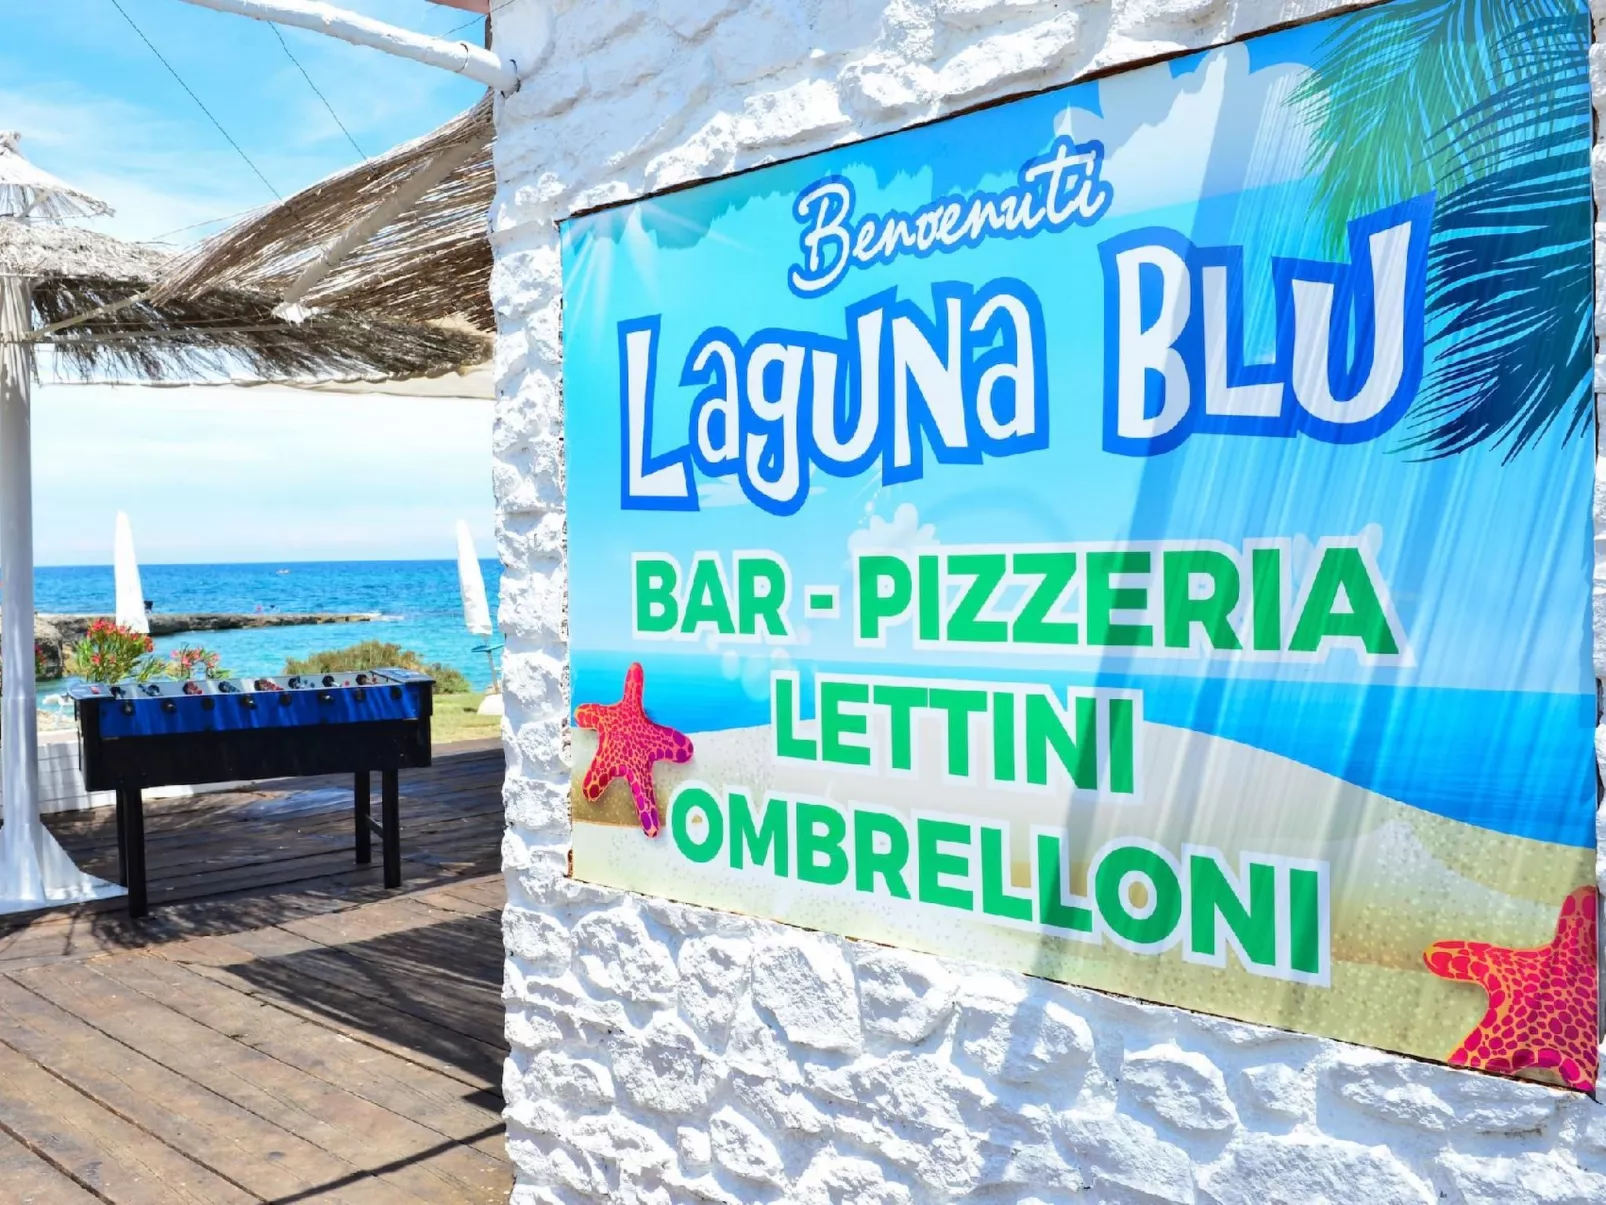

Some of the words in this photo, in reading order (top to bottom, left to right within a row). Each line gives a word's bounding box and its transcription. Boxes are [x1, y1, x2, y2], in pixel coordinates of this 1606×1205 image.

[791, 142, 1106, 292] Benvenuti
[1115, 220, 1412, 439] BLU
[635, 557, 789, 637] BAR
[858, 547, 1400, 655] PIZZERIA
[775, 678, 1134, 795] LETTINI
[670, 787, 1320, 974] OMBRELLONI
